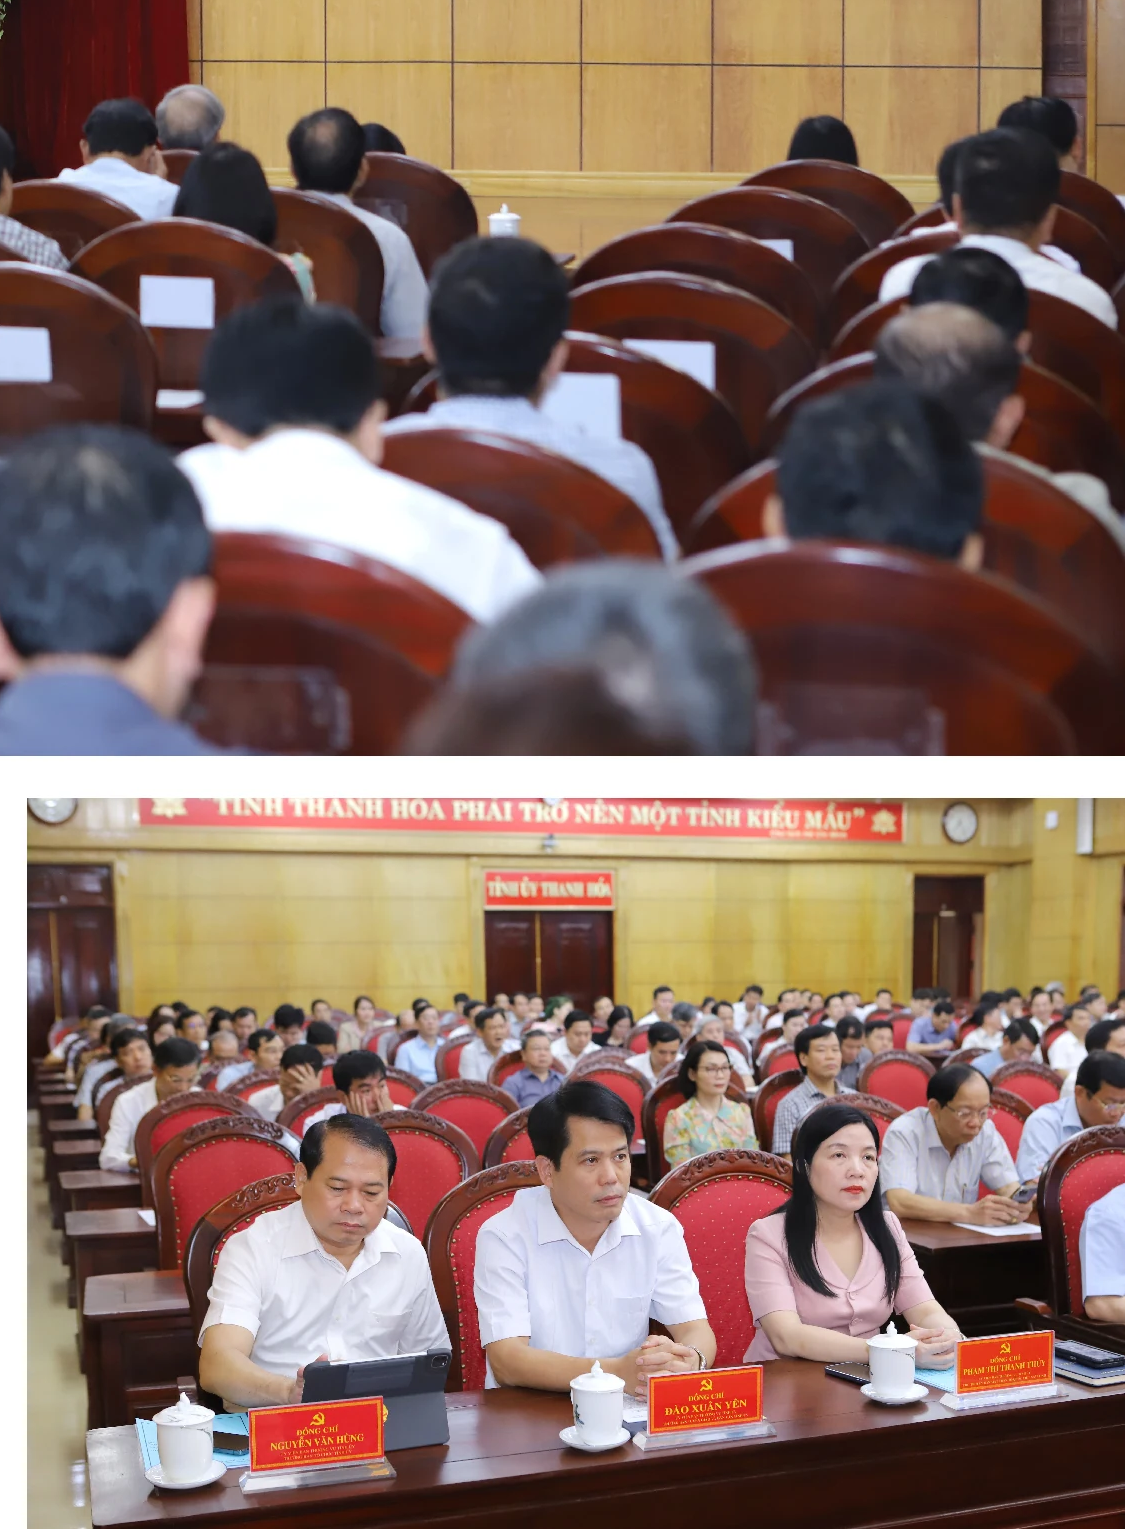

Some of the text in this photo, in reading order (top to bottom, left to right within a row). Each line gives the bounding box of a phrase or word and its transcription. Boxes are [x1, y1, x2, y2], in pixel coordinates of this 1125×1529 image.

[664, 1404, 690, 1416] ĐÀO
[691, 1400, 723, 1414] XUÂN
[725, 1398, 747, 1410] YÊN
[315, 1434, 334, 1447] VĂN
[336, 1432, 365, 1445] HÙNG
